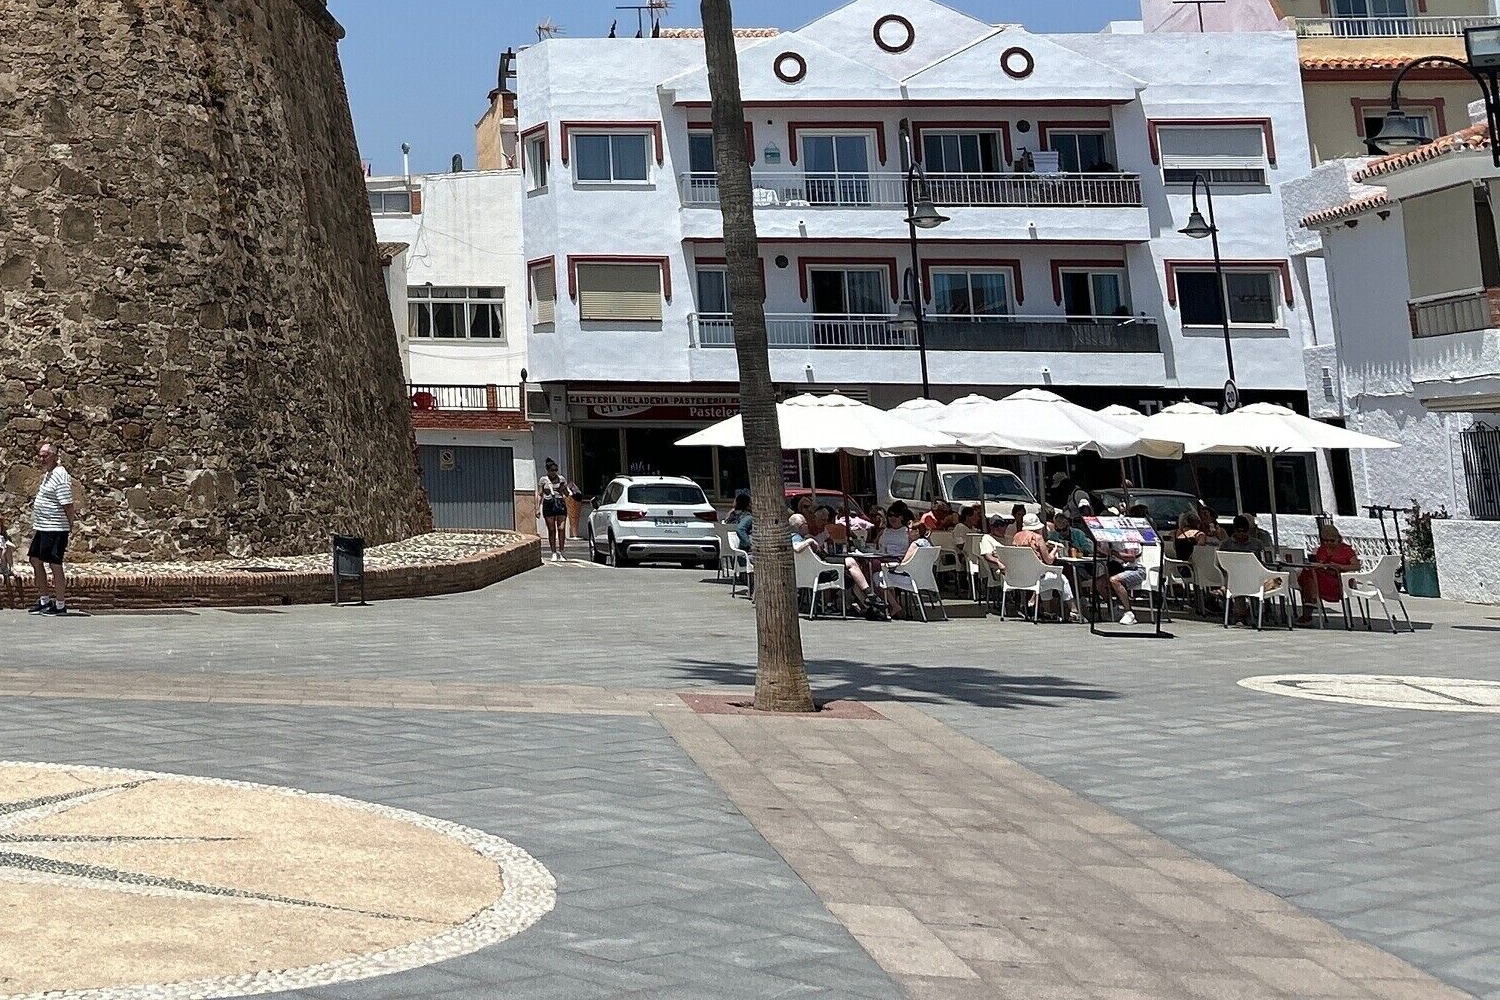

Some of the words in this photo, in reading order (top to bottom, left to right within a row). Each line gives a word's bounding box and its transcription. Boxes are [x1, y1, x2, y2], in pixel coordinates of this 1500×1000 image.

[569, 395, 617, 404] CAFETERIA
[622, 396, 669, 404] HELADERIA
[673, 397, 727, 405] PASTELERIA
[1227, 390, 1235, 403] 20
